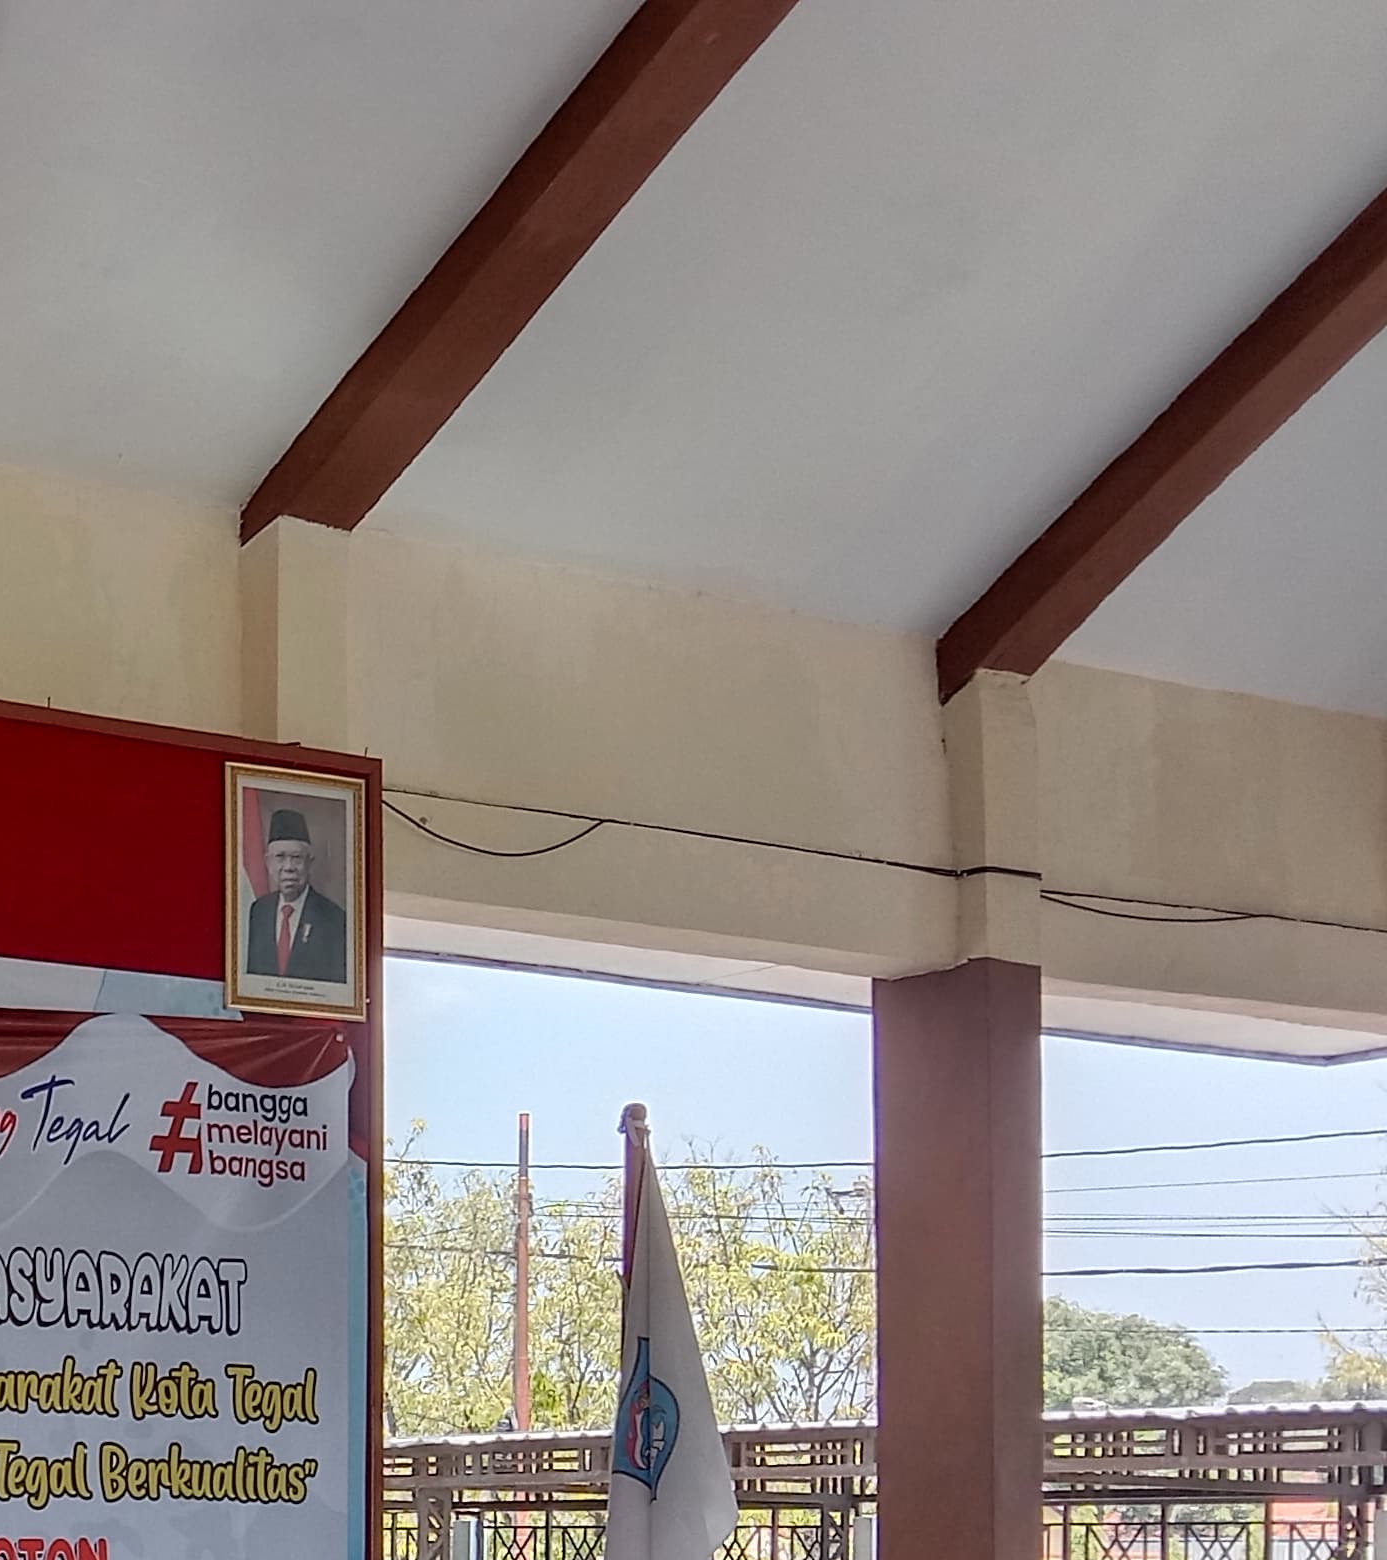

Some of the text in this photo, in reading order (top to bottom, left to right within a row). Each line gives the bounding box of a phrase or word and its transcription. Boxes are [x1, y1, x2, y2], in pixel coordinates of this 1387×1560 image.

[21, 1075, 130, 1165] Tegal
[207, 1084, 308, 1123] bangga
[207, 1120, 327, 1156] melayani
[208, 1149, 306, 1187] bangsa
[131, 1362, 218, 1420] Kota
[226, 1364, 319, 1433] Tegal
